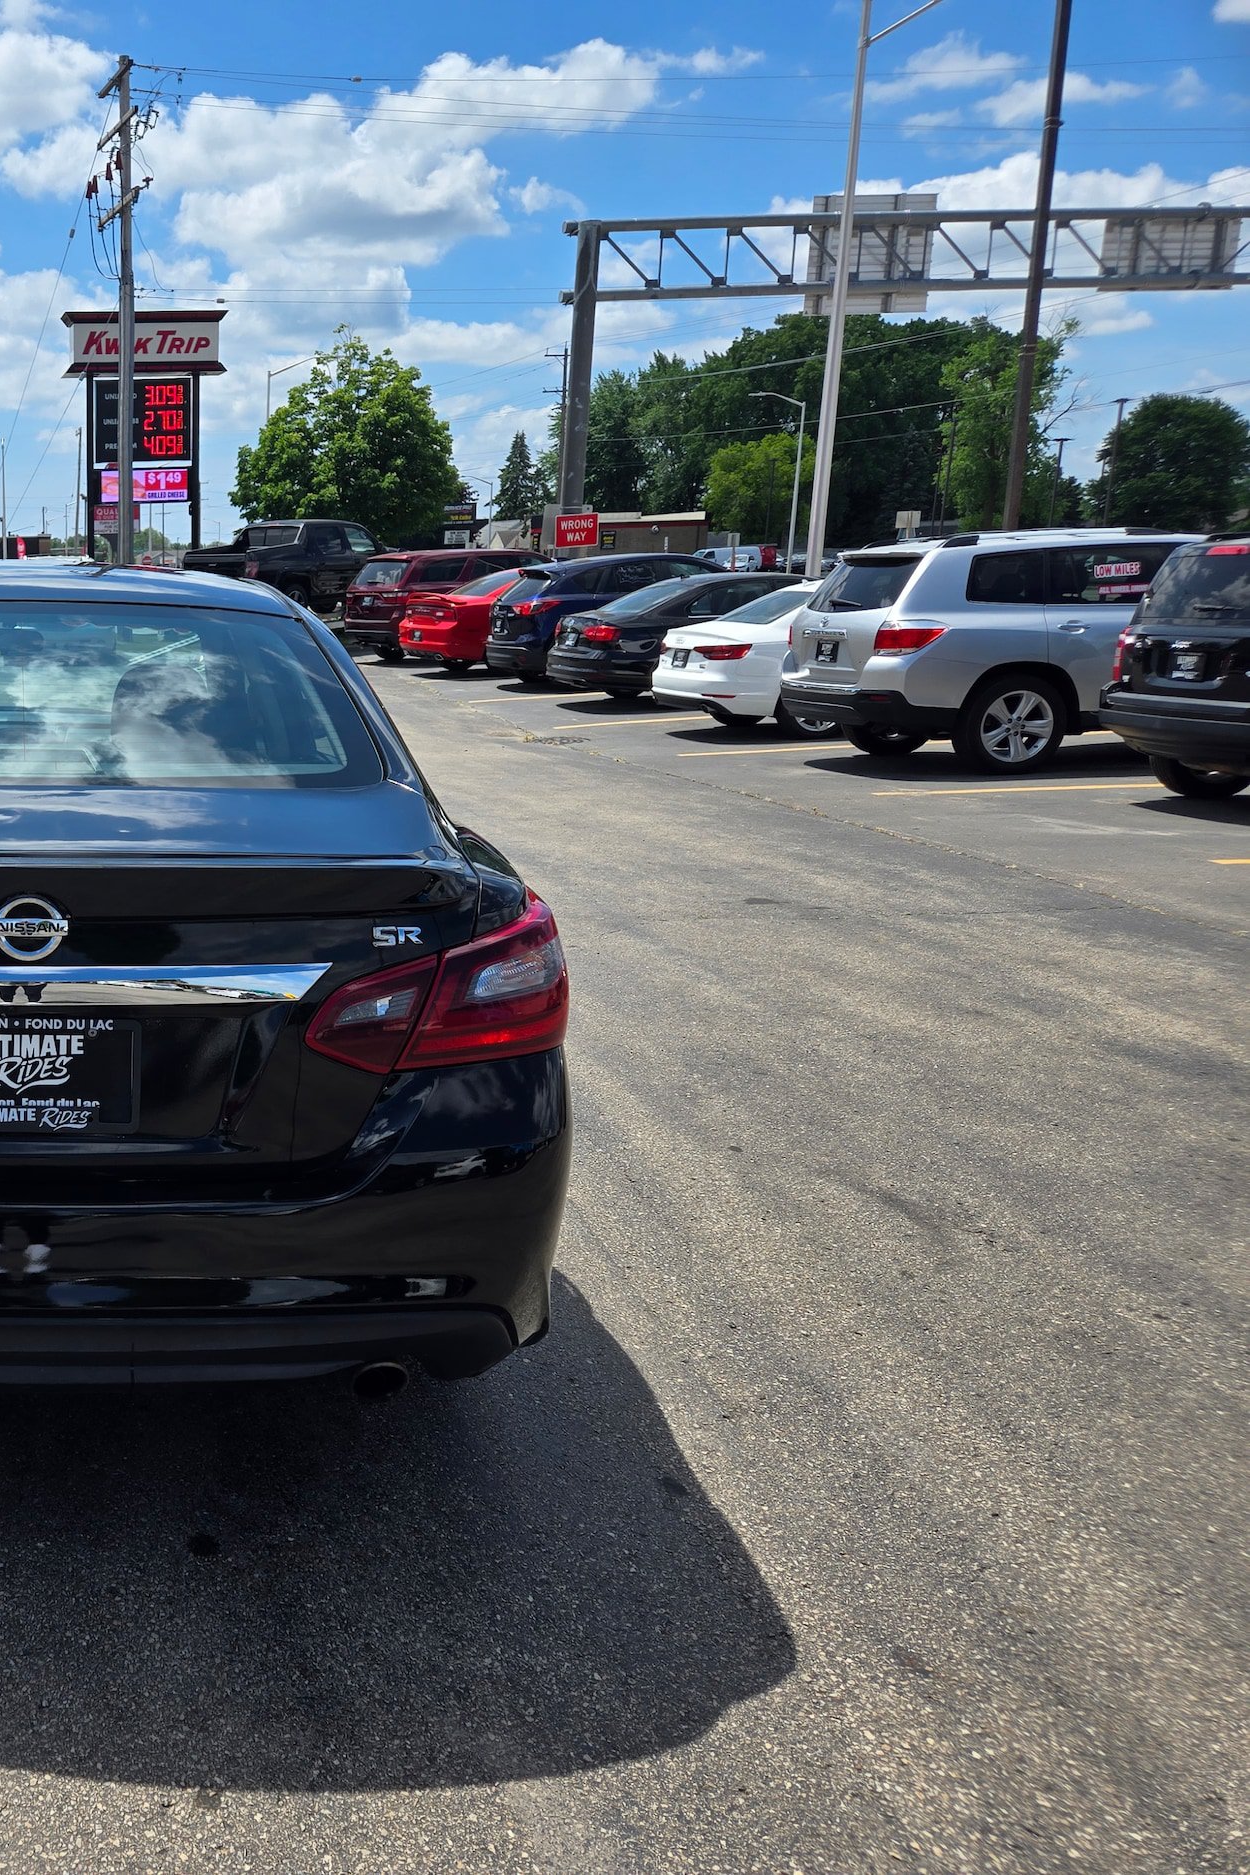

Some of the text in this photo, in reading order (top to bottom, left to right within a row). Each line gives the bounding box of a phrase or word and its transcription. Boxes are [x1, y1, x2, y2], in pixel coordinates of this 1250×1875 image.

[156, 330, 211, 354] TRIP
[560, 518, 594, 531] WRONG
[566, 531, 587, 543] WAY
[1094, 562, 1140, 578] LOW MILES
[372, 925, 424, 948] SR
[25, 1018, 63, 1030] FOND
[66, 1019, 86, 1030] DU
[89, 1019, 114, 1031] LAC
